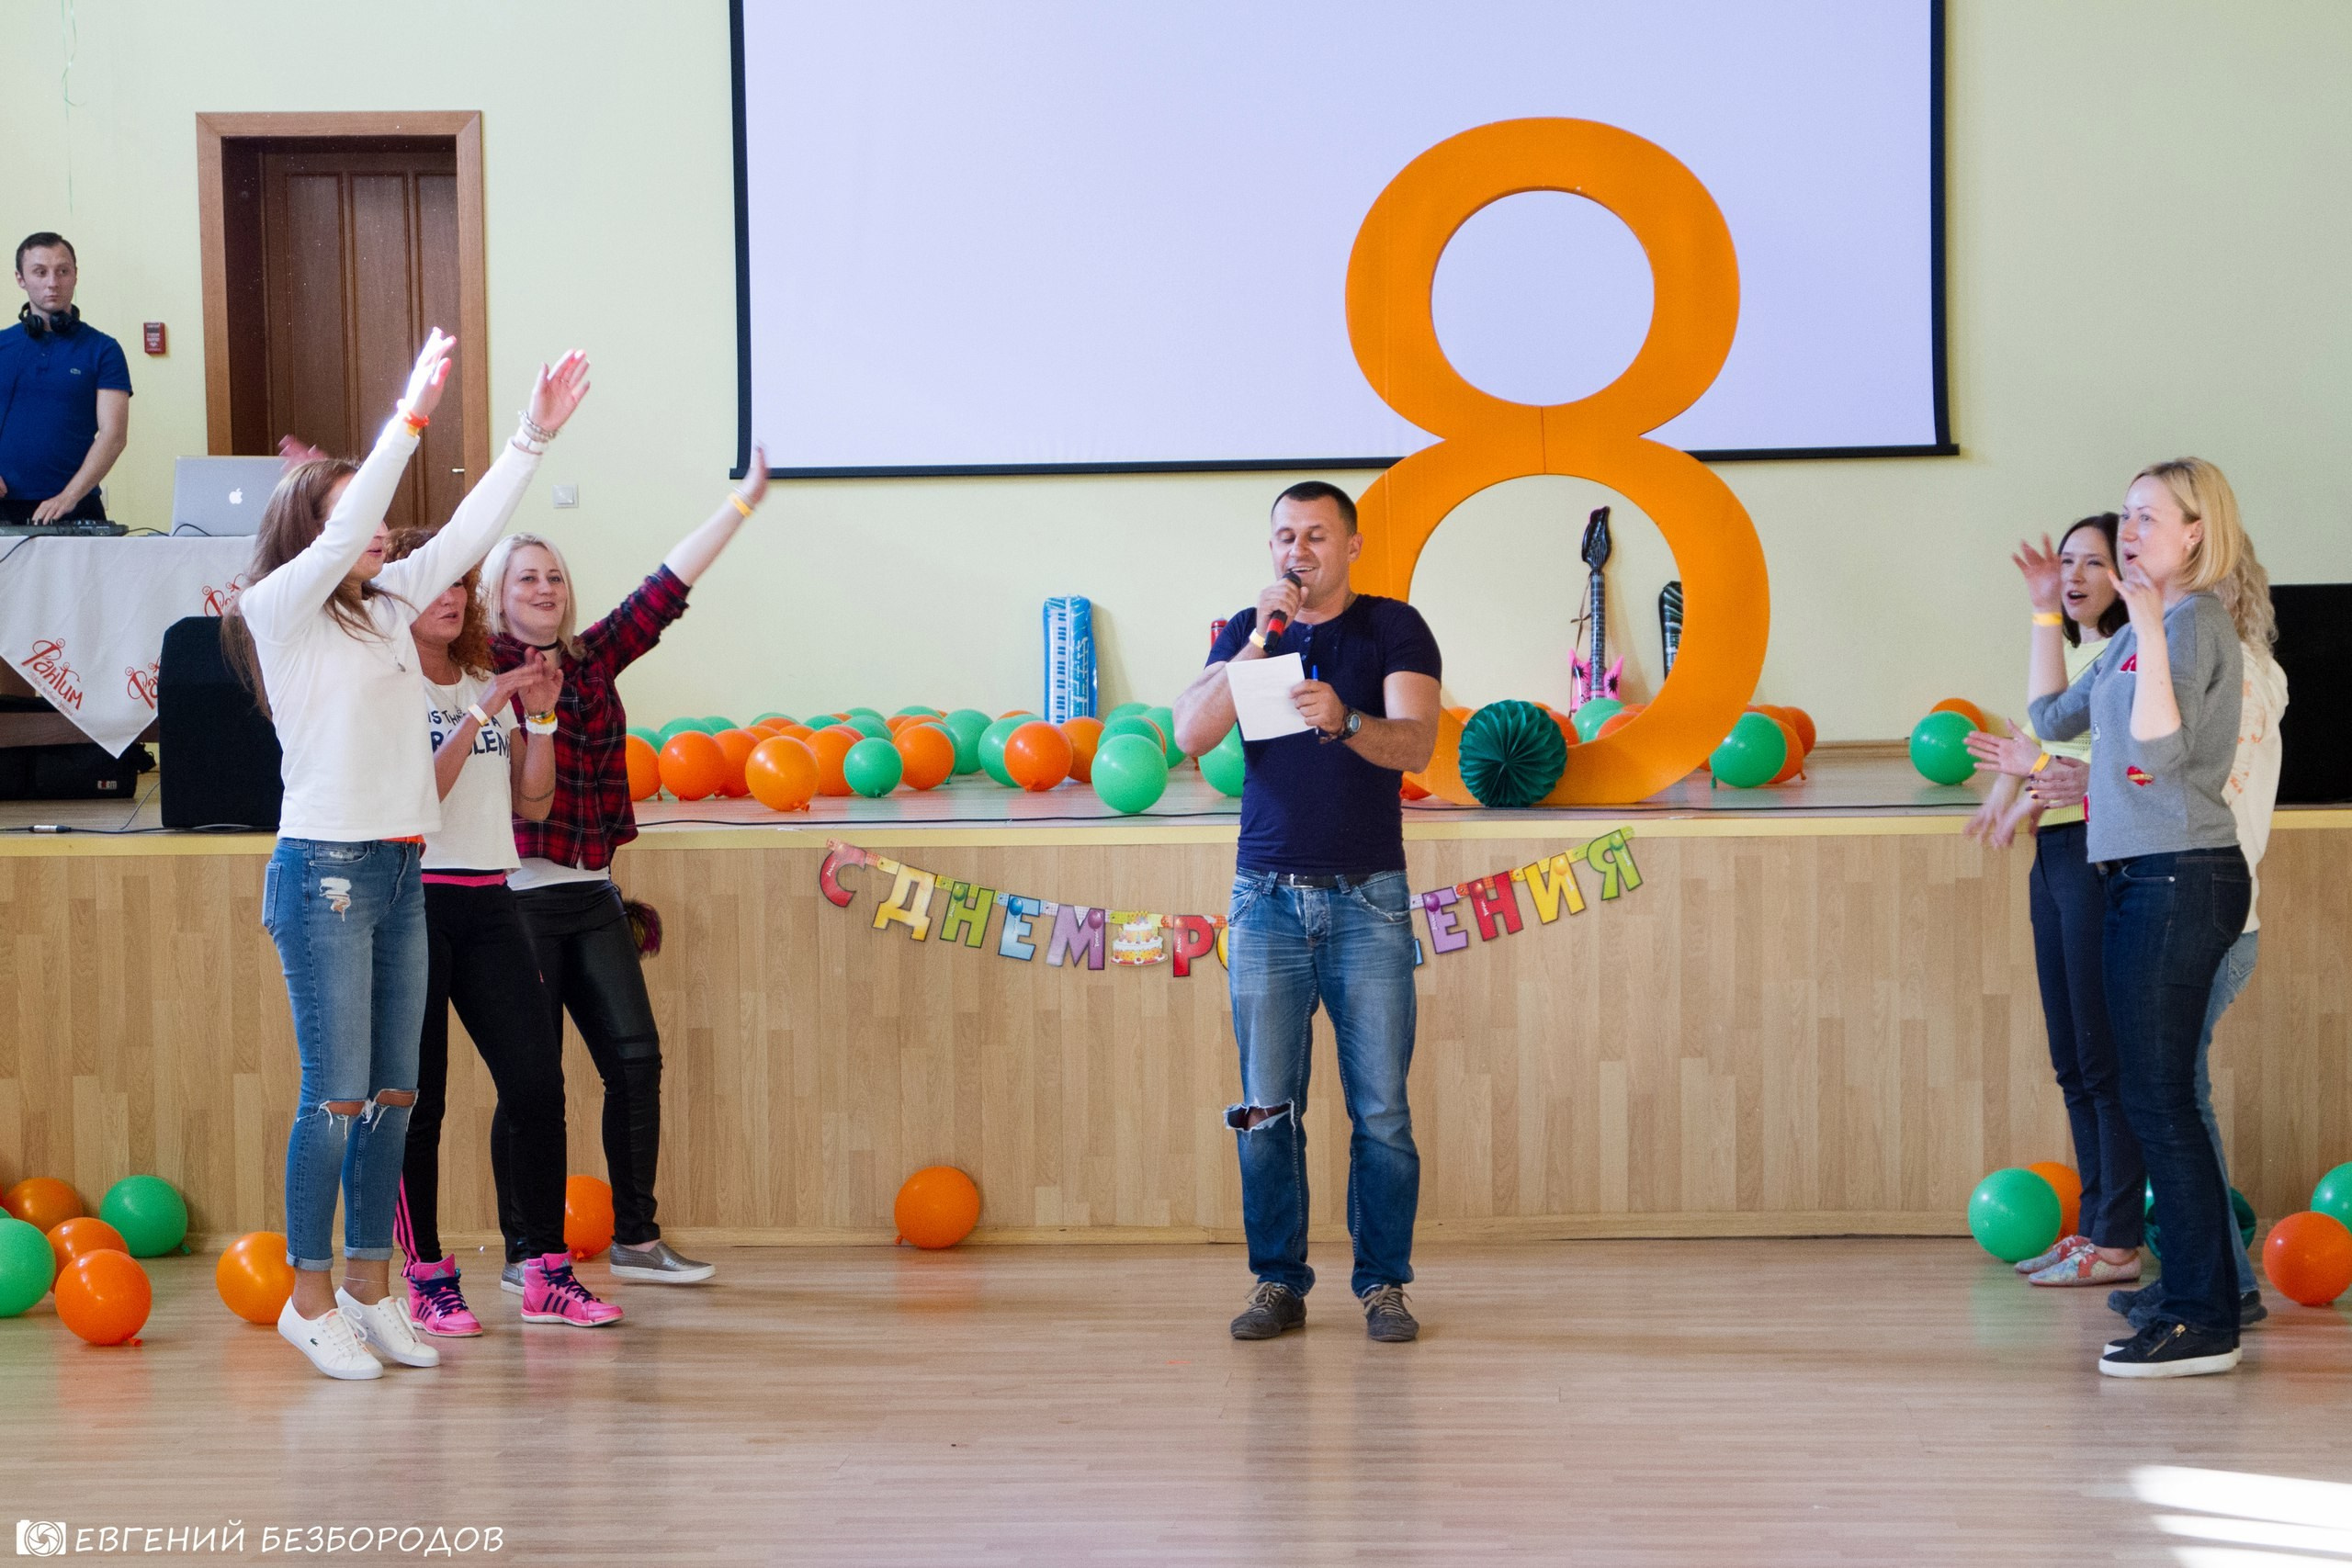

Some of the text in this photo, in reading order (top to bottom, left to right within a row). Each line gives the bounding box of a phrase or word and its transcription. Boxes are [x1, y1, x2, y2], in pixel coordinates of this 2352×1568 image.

[819, 829, 1643, 977] С ДНЕМ РЕНИЯ
